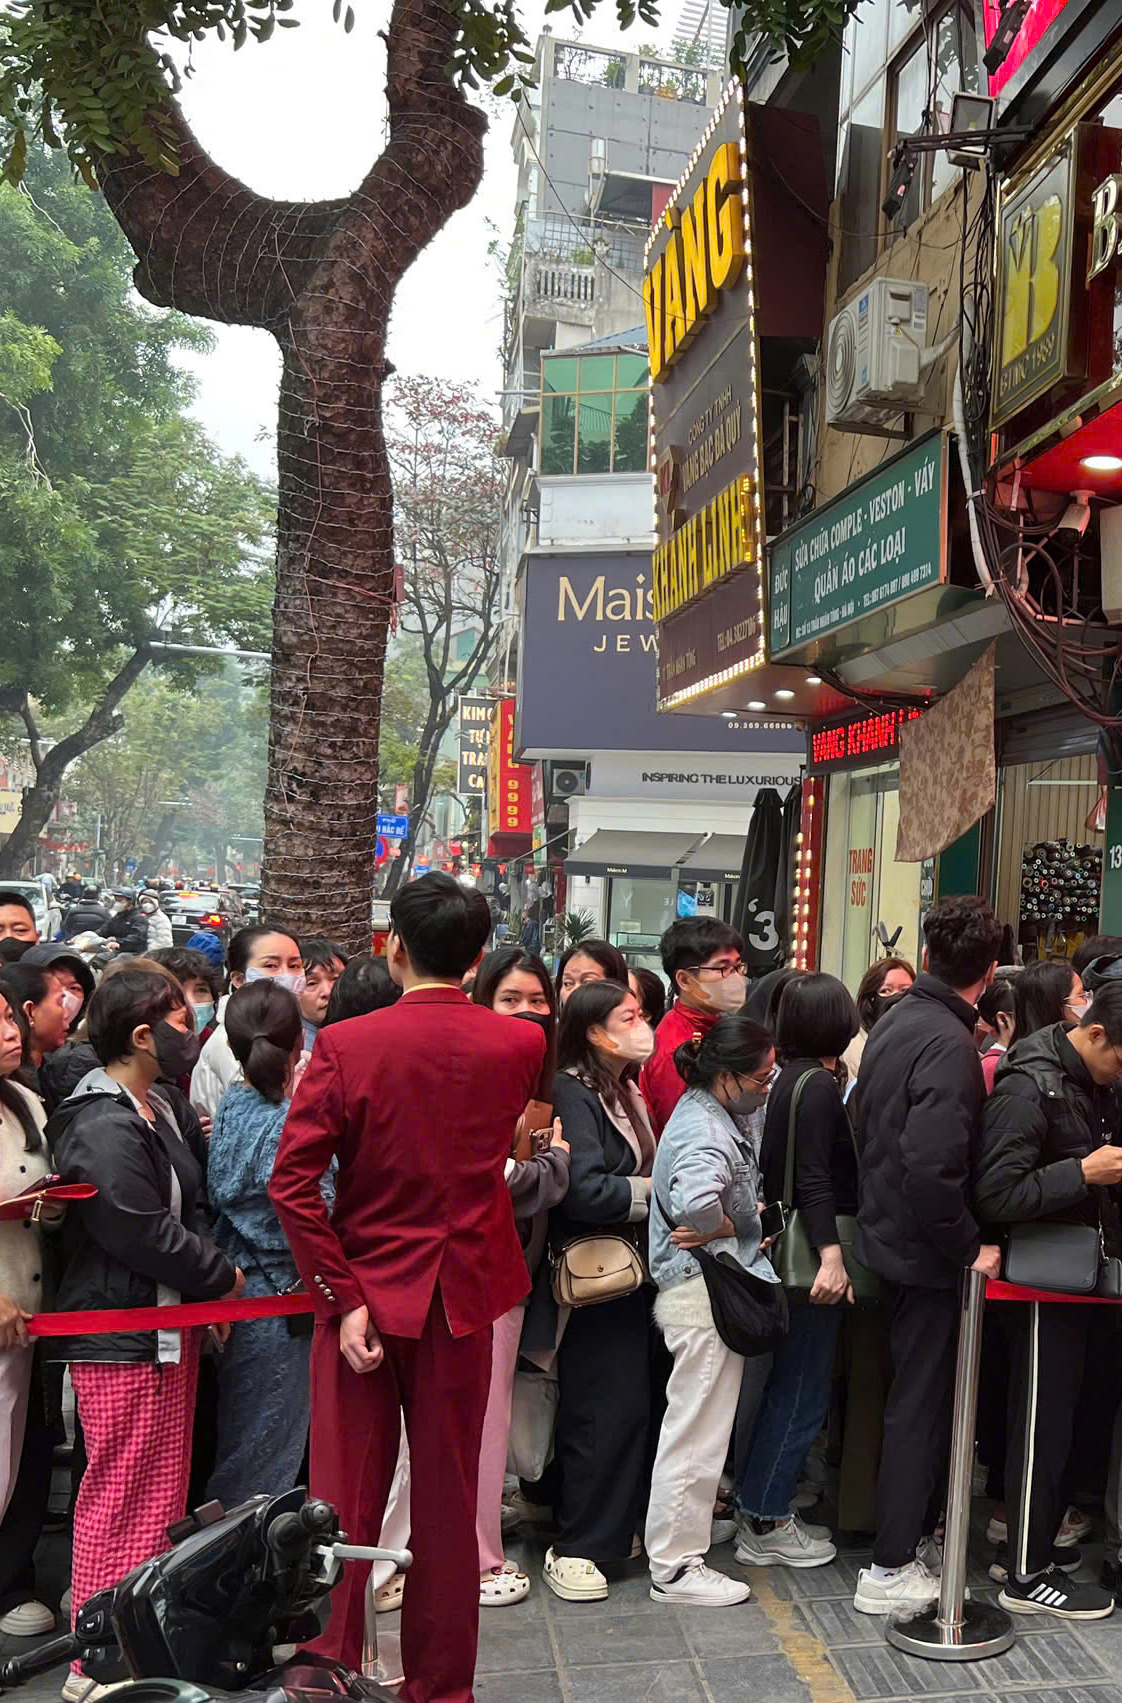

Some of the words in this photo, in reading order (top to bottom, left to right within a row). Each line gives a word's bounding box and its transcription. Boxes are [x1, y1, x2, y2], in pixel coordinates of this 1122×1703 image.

[643, 142, 742, 384] VÀNG
[830, 507, 863, 550] COMPLE
[868, 480, 905, 526] VESTON
[913, 456, 936, 498] VÁY
[814, 559, 839, 603] QUẦN
[841, 552, 855, 586] ÁO
[858, 538, 878, 576] CÁC
[880, 527, 906, 565] LOẠI
[462, 706, 486, 721] KIM
[462, 751, 488, 766] TRA
[642, 772, 699, 784] INSPIRING
[701, 774, 728, 784] THE
[728, 775, 802, 787] LUXURIOUS
[507, 779, 520, 828] 9999
[849, 848, 873, 874] TRANG
[1109, 845, 1122, 869] 13
[851, 877, 867, 907] SỨC
